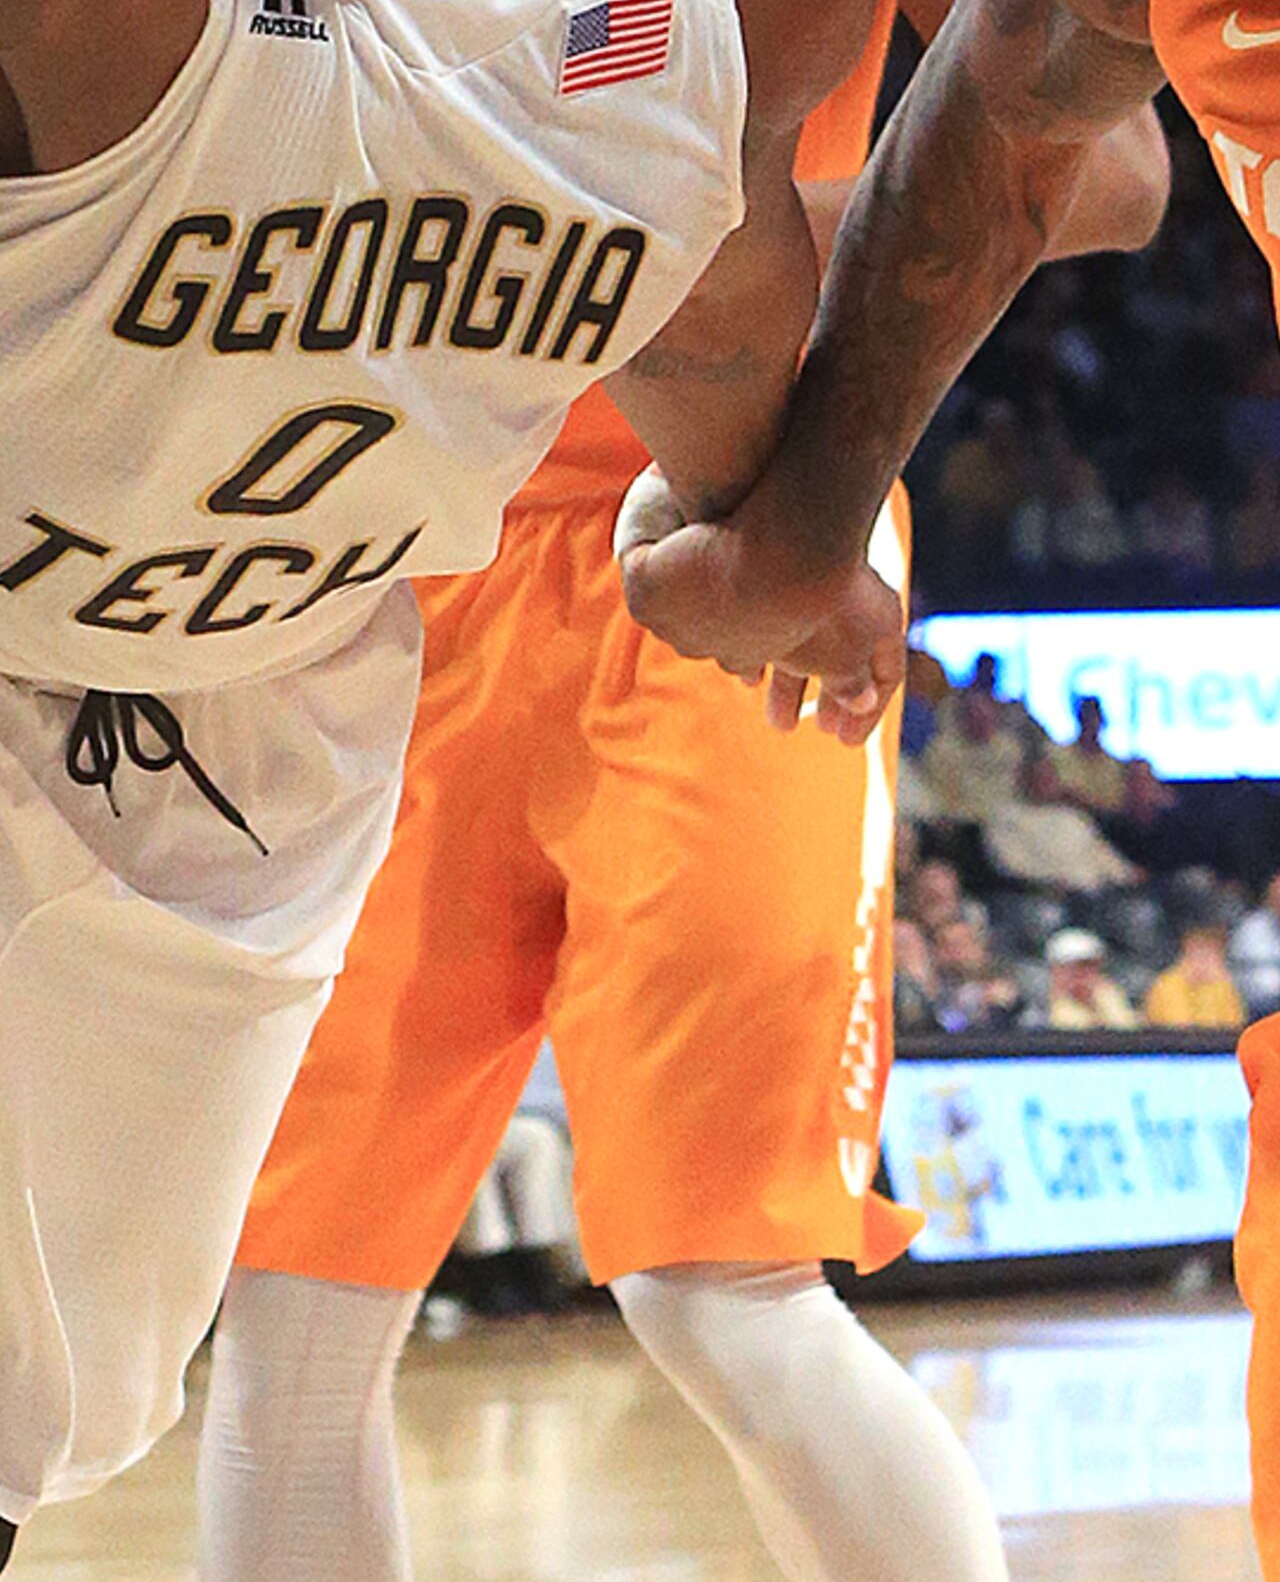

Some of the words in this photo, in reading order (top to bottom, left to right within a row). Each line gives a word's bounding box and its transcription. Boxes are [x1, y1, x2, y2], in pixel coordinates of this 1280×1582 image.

[249, 13, 329, 42] RUSSELL
[110, 193, 650, 367] GEORGIA
[202, 397, 404, 518] 0
